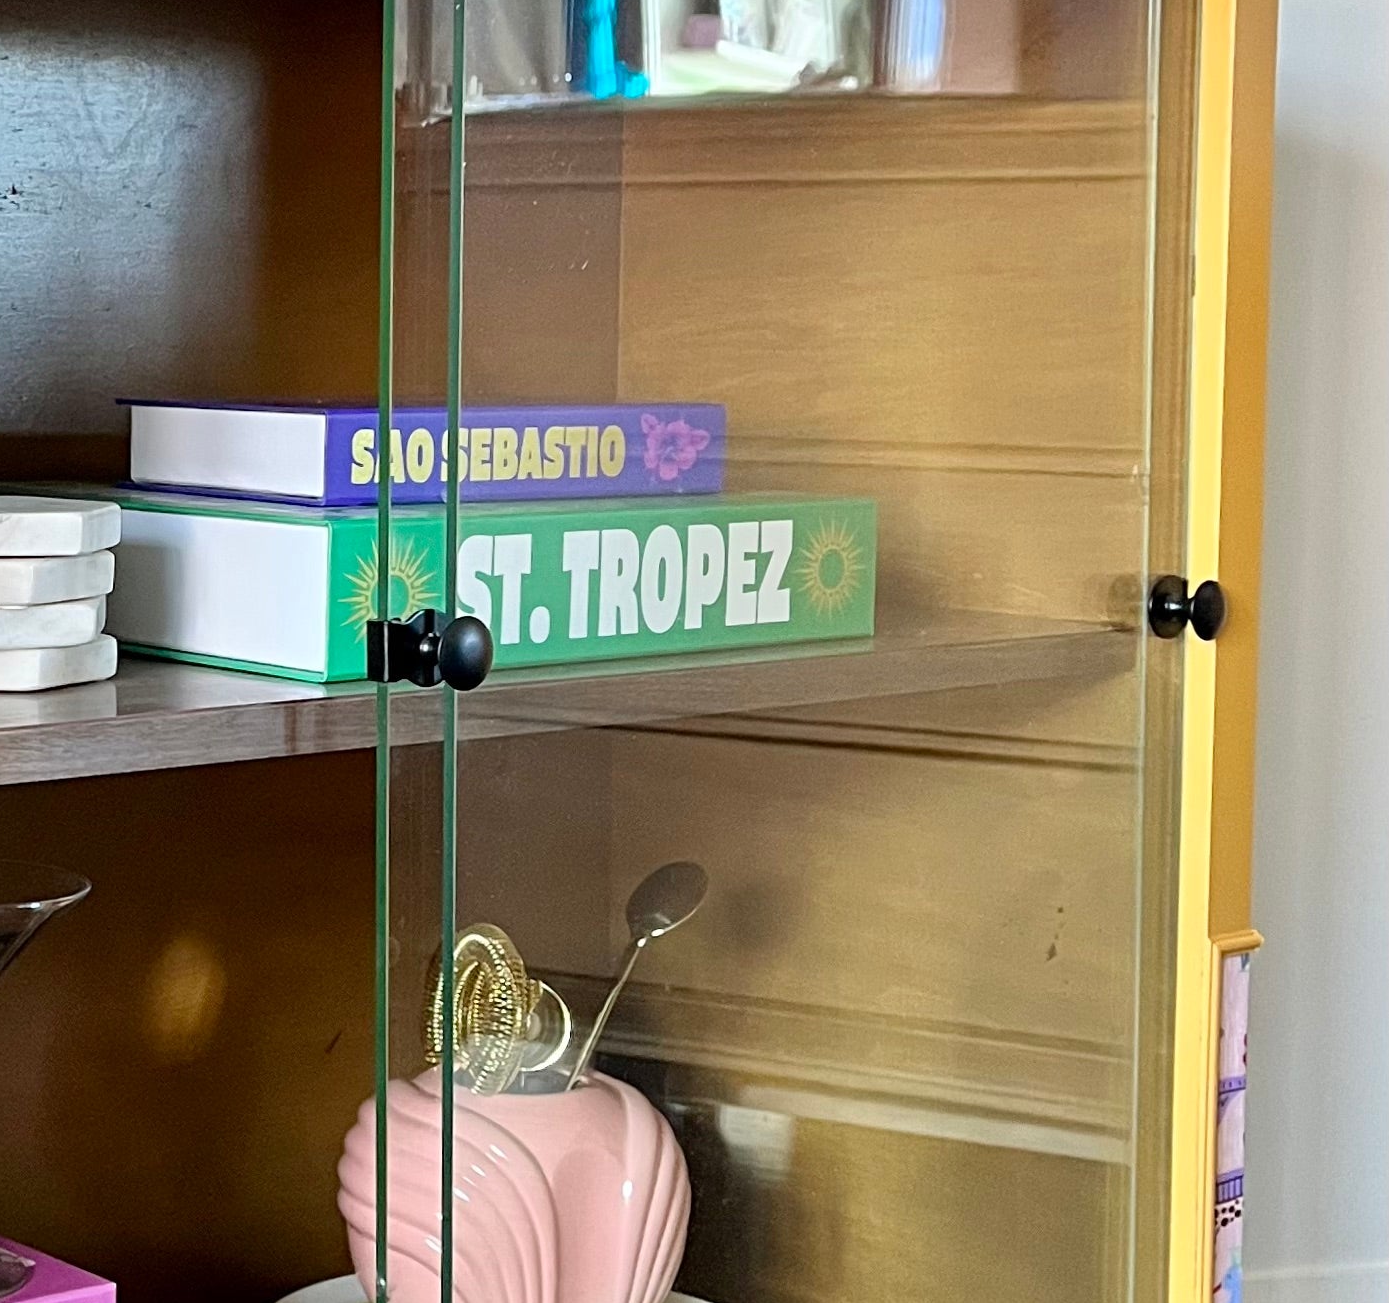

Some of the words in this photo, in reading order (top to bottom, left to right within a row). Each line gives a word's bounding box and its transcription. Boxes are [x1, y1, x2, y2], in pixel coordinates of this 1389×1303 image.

[351, 428, 434, 485] SAO
[441, 424, 626, 482] SEBASTIO
[456, 533, 552, 644] ST.
[562, 519, 793, 639] TROPEZ
